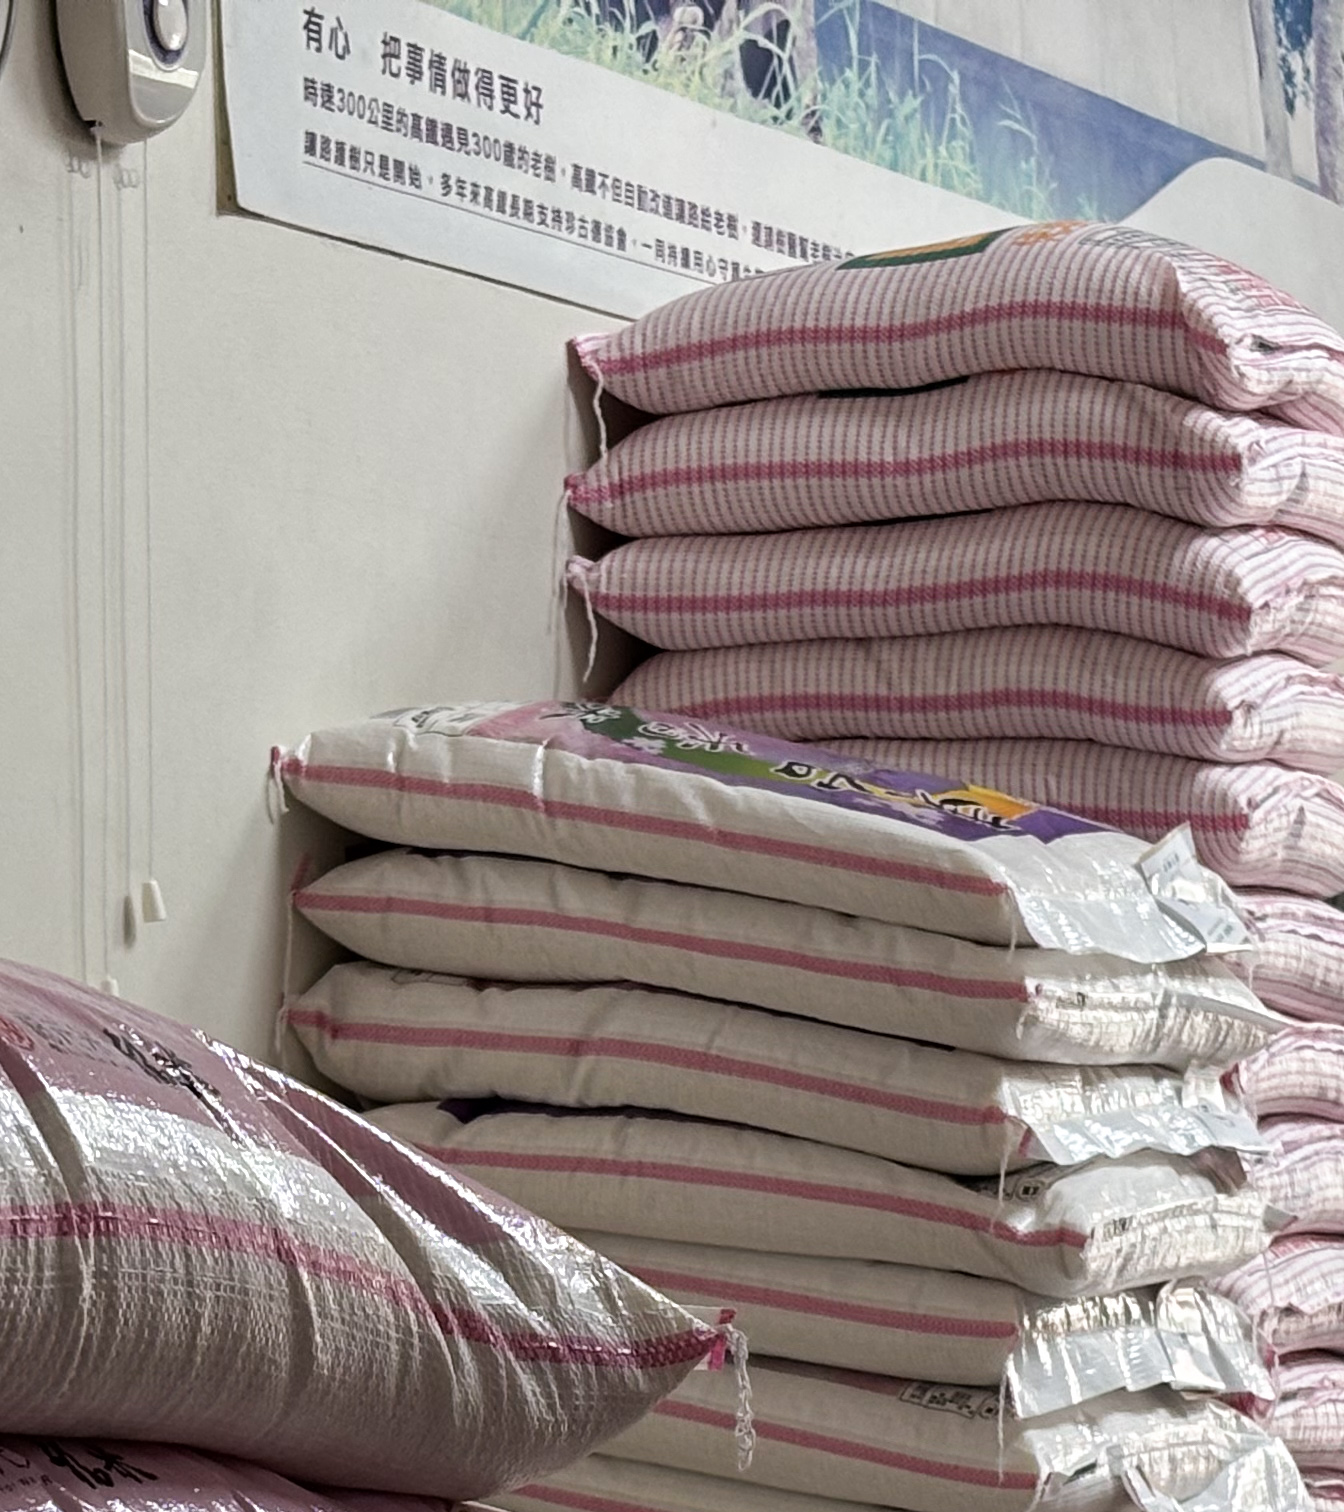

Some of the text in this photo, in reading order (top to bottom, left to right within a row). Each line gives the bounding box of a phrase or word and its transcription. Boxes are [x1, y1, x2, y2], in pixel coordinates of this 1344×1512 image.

[302, 6, 544, 127] 有心 把事情做得更好
